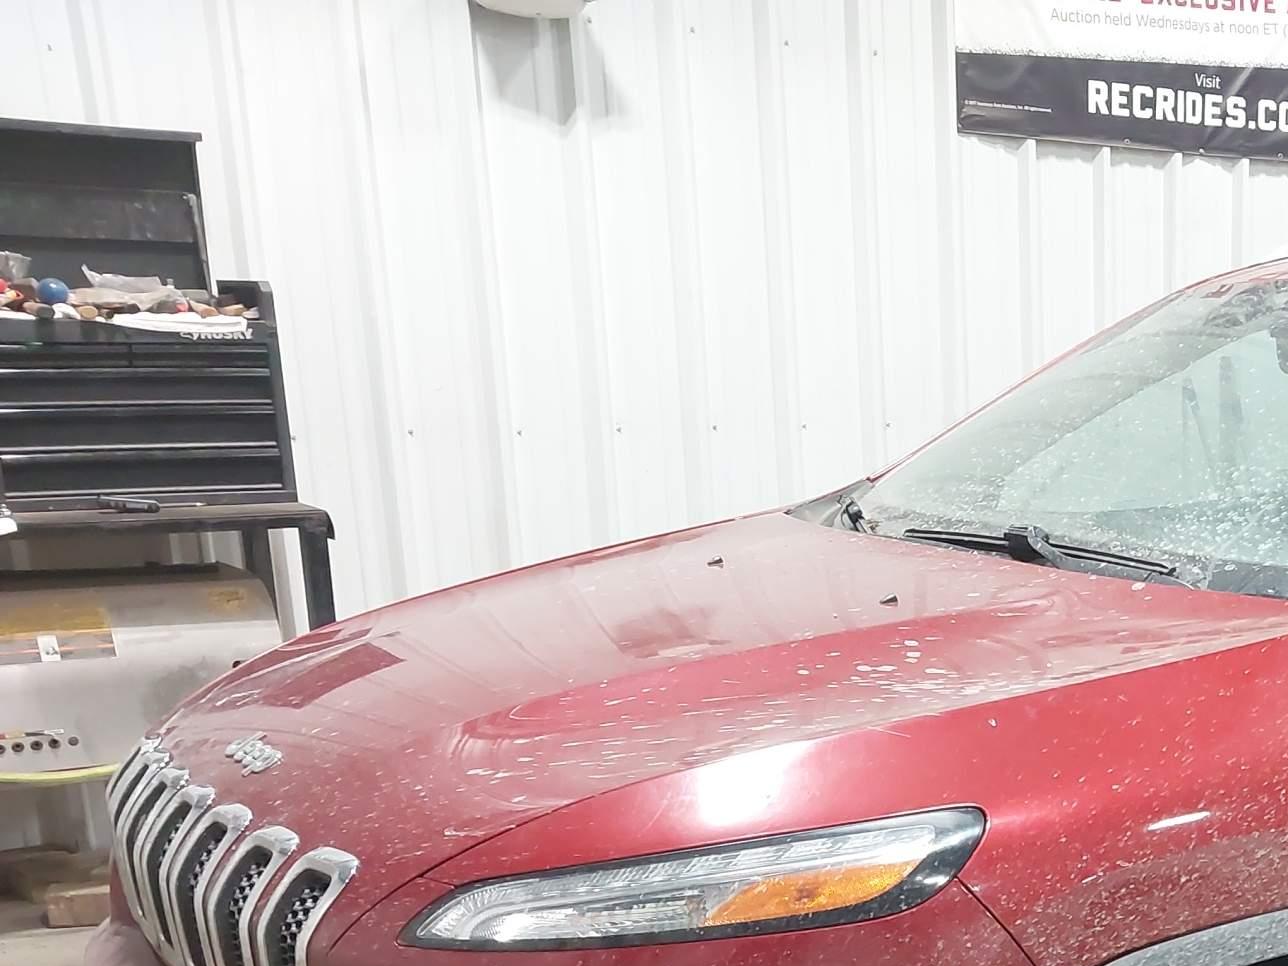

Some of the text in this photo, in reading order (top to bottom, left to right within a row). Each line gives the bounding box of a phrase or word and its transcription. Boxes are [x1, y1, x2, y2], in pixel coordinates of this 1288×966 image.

[1050, 8, 1100, 25] Auction
[1104, 12, 1131, 27] held
[1136, 14, 1210, 33] Wednesdays
[1212, 20, 1225, 33] at
[1229, 23, 1259, 35] noon
[1195, 72, 1222, 90] Visit
